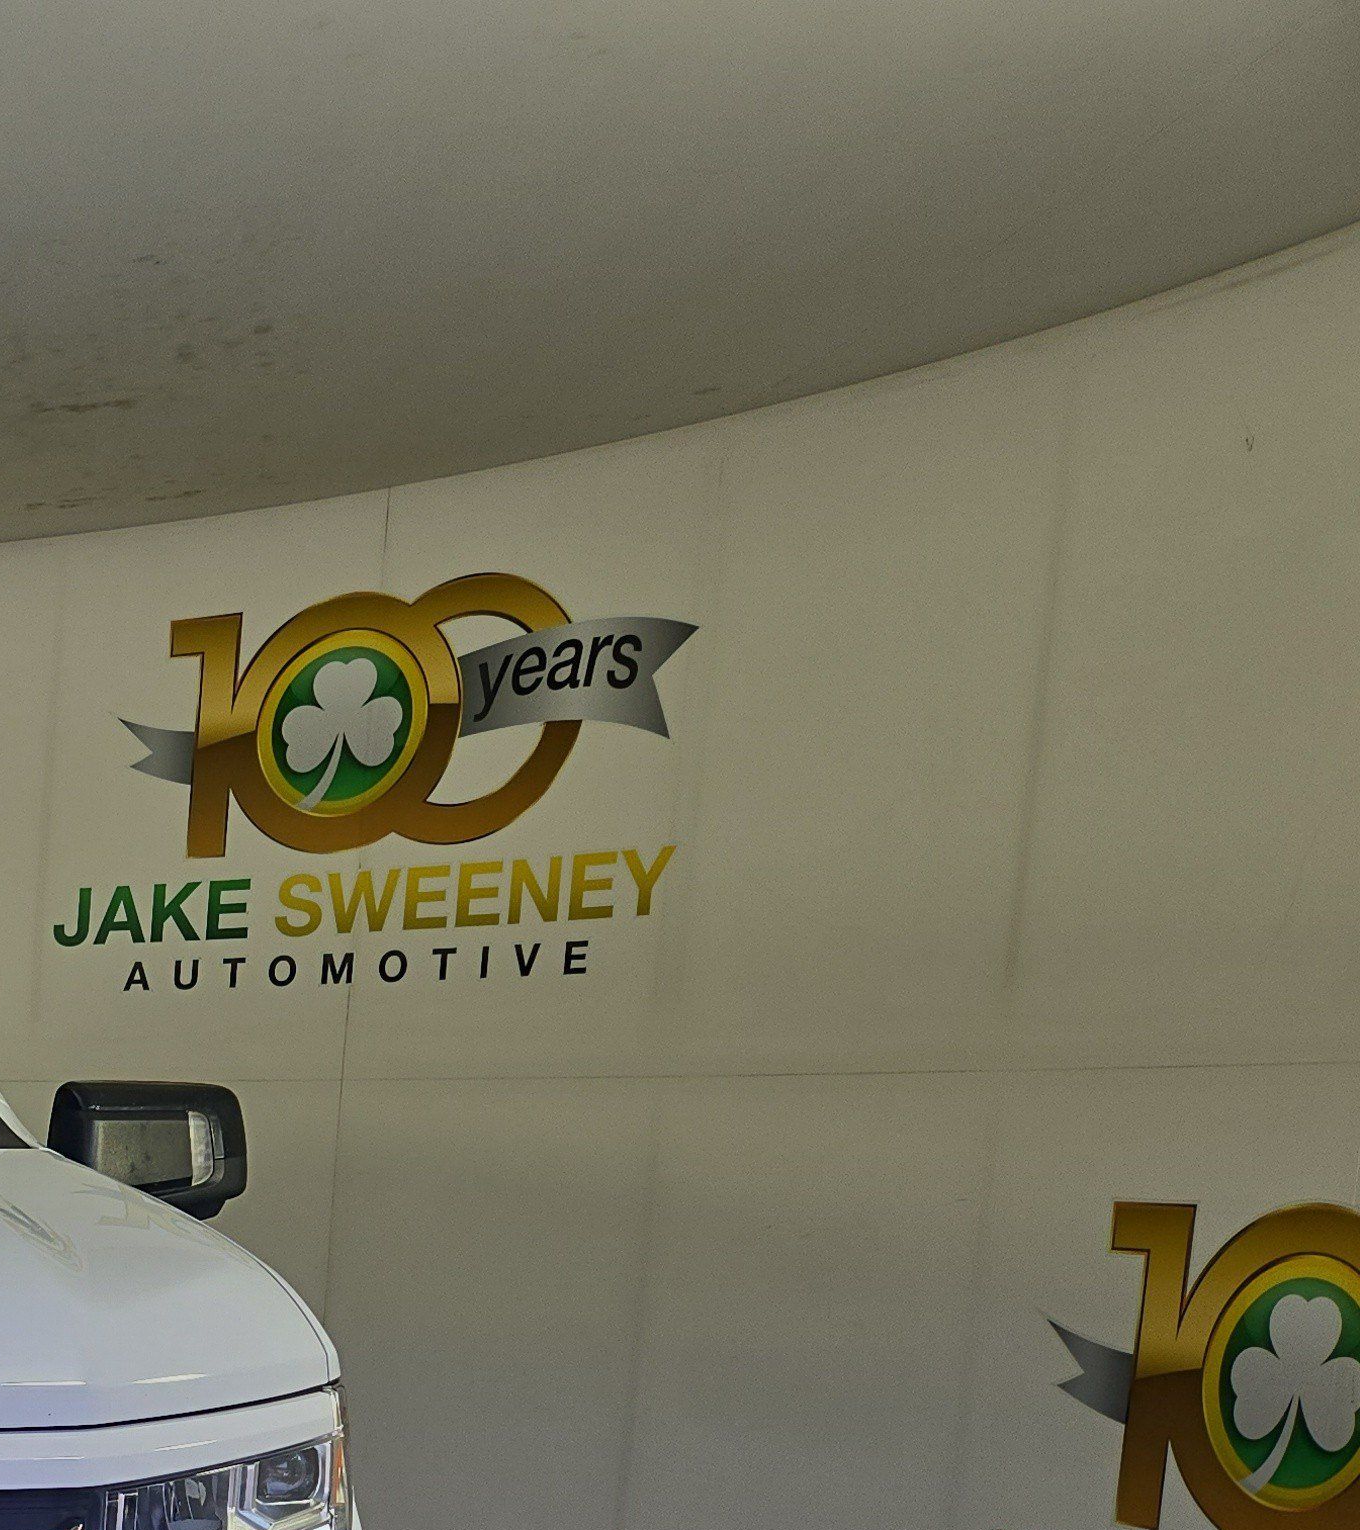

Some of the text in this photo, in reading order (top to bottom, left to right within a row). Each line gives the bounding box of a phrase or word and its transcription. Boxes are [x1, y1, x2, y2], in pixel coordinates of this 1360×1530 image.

[170, 572, 643, 859] 100 years
[52, 844, 677, 947] JAKE SWEENEY
[123, 940, 590, 992] AUTOMOTIVE
